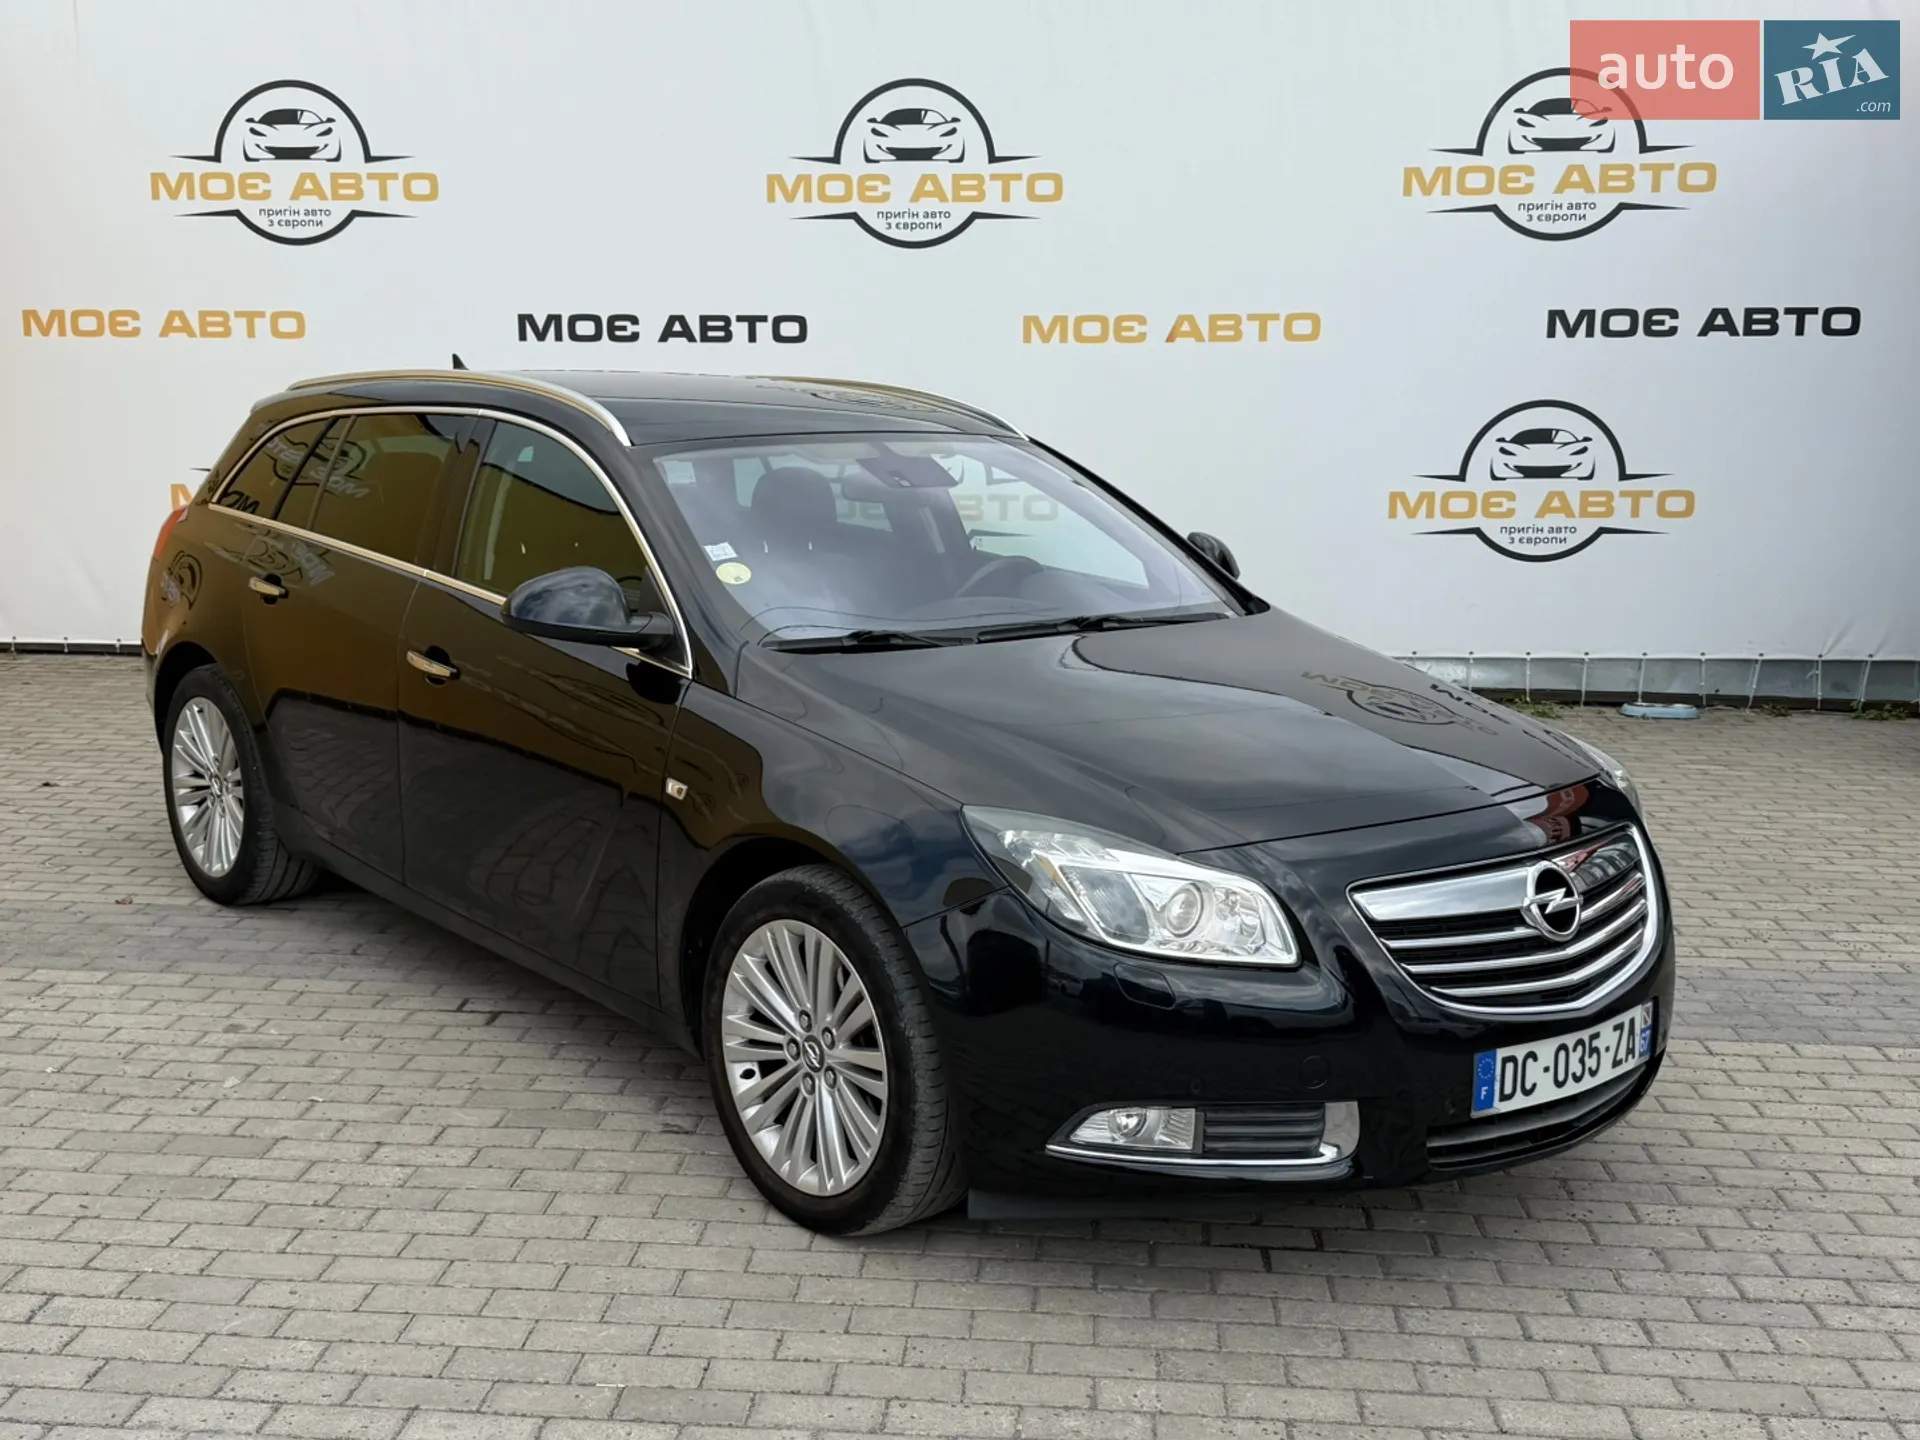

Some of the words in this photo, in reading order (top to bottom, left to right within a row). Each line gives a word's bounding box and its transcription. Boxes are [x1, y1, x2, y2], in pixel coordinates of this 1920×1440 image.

[150, 172, 272, 202] МОЄ
[289, 172, 440, 203] АВТО
[766, 173, 891, 204] МОЄ
[909, 172, 1064, 204] АВТО
[1402, 164, 1536, 197] МОЄ
[1553, 162, 1718, 195] АВТО
[258, 206, 300, 220] пригін
[303, 208, 332, 218] авто
[876, 208, 919, 222] пригін
[922, 210, 952, 219] авто
[1517, 200, 1562, 214] пригін
[1566, 201, 1597, 211] авто
[1526, 213, 1533, 223] з
[1536, 212, 1587, 225] європи
[267, 219, 274, 229] з
[276, 218, 323, 230] європи
[885, 221, 892, 231] з
[896, 221, 943, 232] європи
[21, 309, 141, 339] МОЄ
[158, 309, 306, 340] АВТО
[517, 313, 640, 343] МОЄ
[657, 314, 808, 344] АВТО
[1022, 314, 1148, 345] МОЄ
[1165, 312, 1322, 344] АВТО
[1546, 308, 1680, 339] МОЄ
[1696, 306, 1862, 337] АВТО
[957, 494, 1059, 522] ВТО
[1388, 490, 1517, 520] МОЄ
[1535, 489, 1696, 519] АВТО
[1500, 523, 1545, 536] пригін
[1547, 525, 1578, 535] авто
[1508, 536, 1515, 545] з
[1518, 535, 1568, 547] європи
[1499, 1016, 1636, 1103] DC-035-ZA
[1480, 1086, 1489, 1100] F
